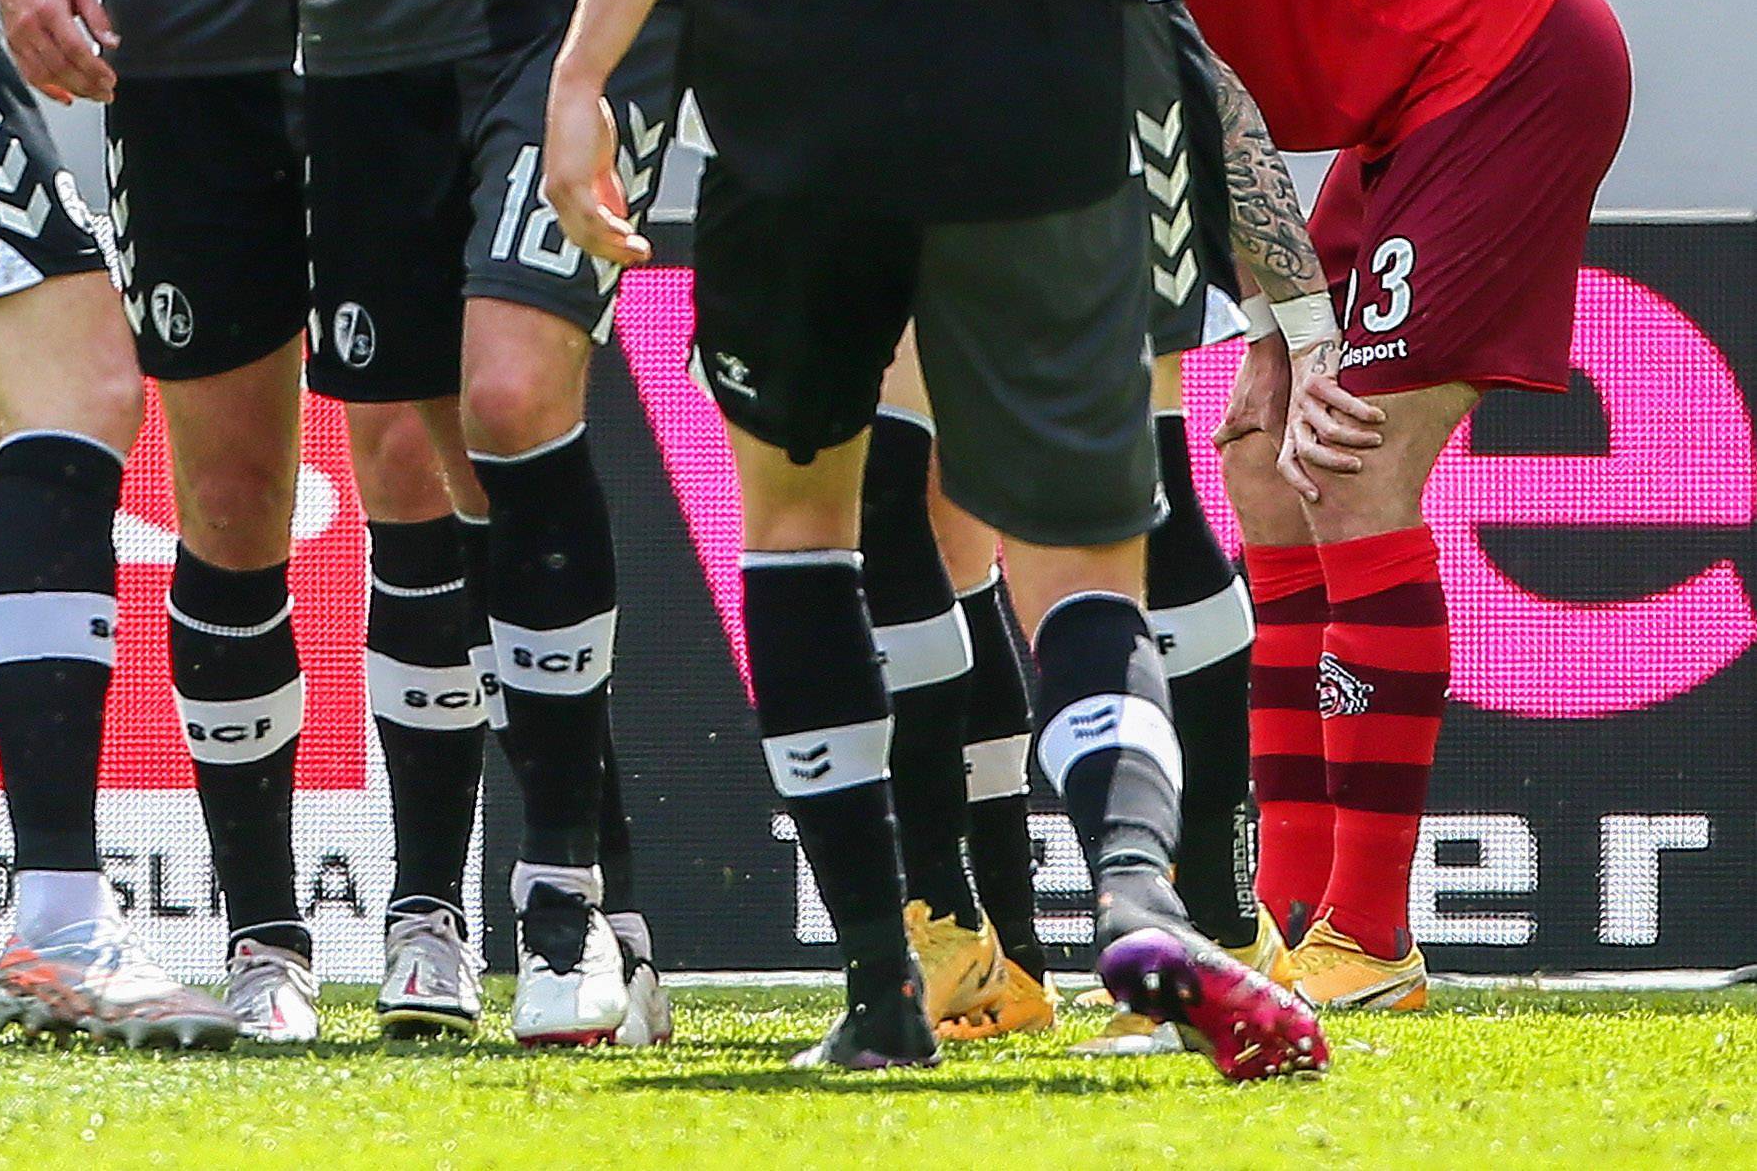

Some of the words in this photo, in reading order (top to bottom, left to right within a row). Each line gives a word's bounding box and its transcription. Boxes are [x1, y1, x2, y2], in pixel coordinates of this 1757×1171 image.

[1343, 236, 1416, 333] 3
[513, 646, 593, 673] SCF
[187, 717, 273, 742] SCF
